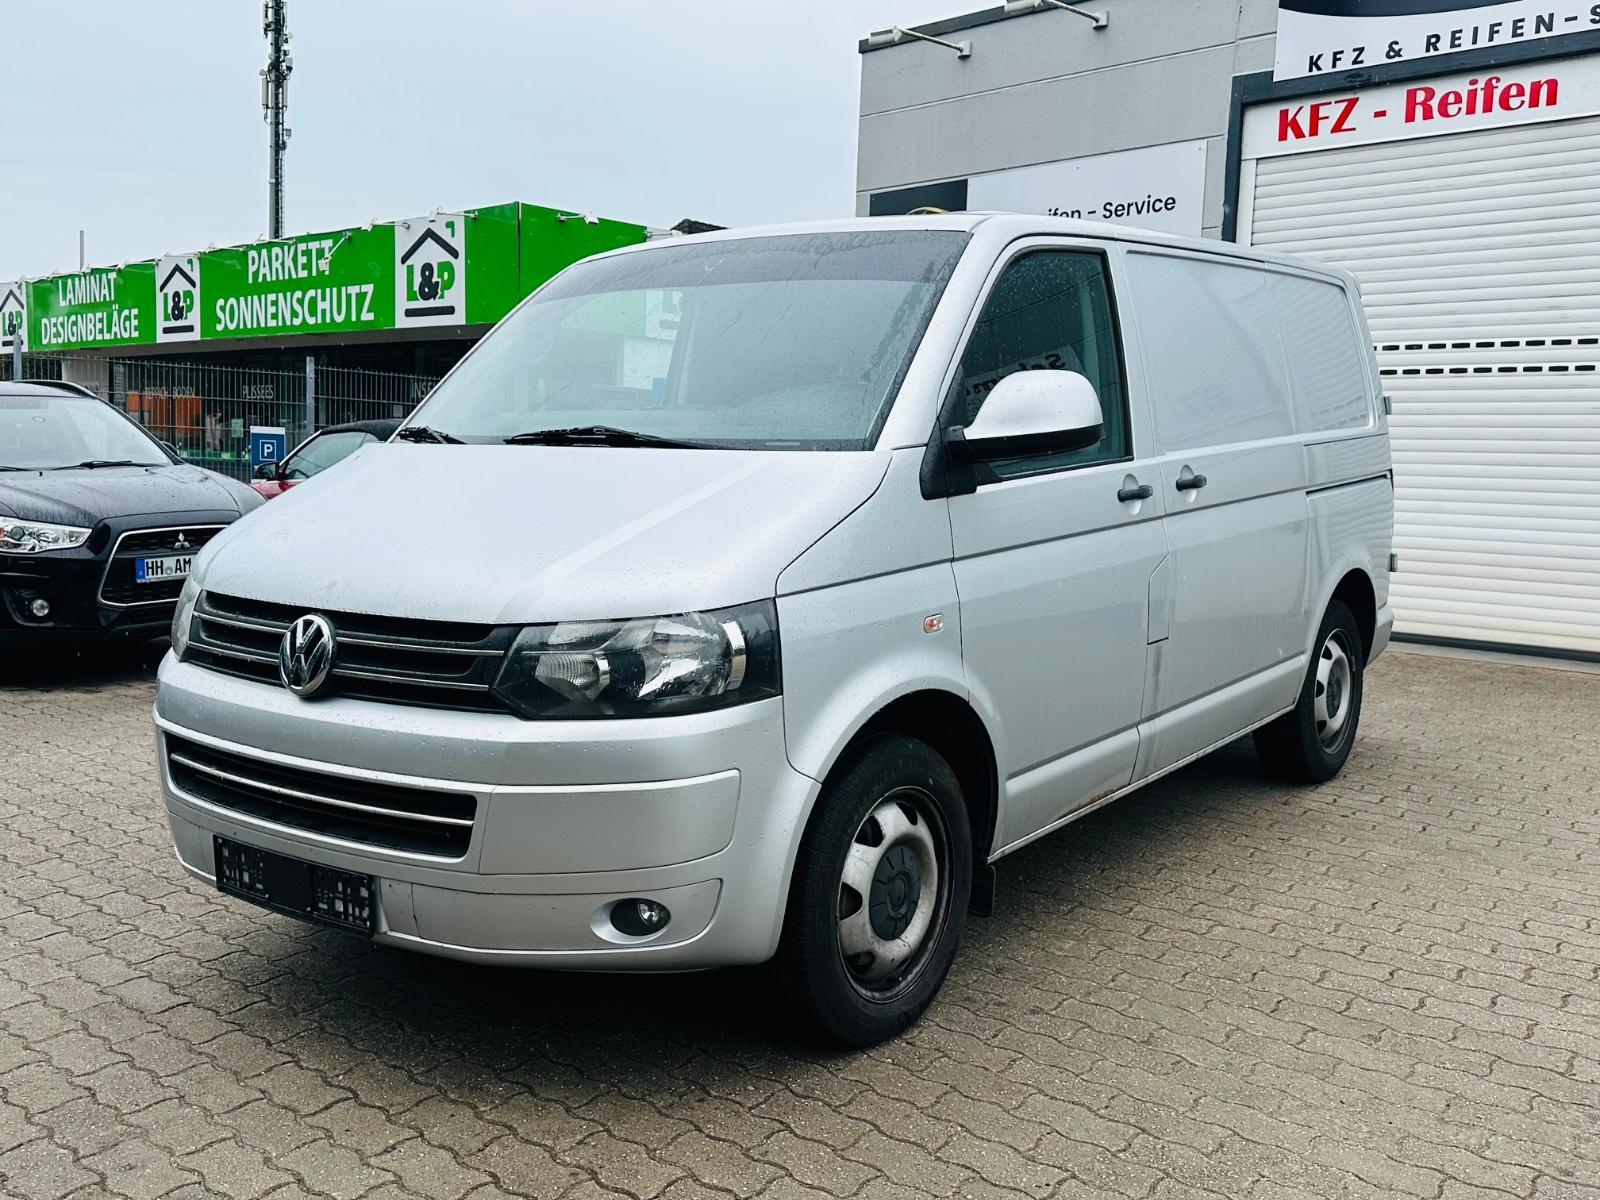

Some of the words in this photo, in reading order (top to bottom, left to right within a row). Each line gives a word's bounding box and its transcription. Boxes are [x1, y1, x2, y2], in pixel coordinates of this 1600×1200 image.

[1308, 47, 1366, 73] KFZ
[1385, 40, 1403, 60] &
[1277, 97, 1360, 142] KFZ
[1373, 109, 1387, 118] -
[1404, 76, 1559, 124] Reifen
[1102, 194, 1177, 219] Service
[248, 239, 334, 283] PARKETT
[58, 272, 117, 307] LAMINAT
[406, 261, 455, 301] L&P
[163, 289, 194, 322] L&P
[215, 284, 375, 331] SONNENSCHUTZ
[41, 308, 139, 345] DESIGNBELÄGE
[264, 444, 273, 456] P
[145, 559, 164, 577] HH
[174, 557, 192, 574] AM
